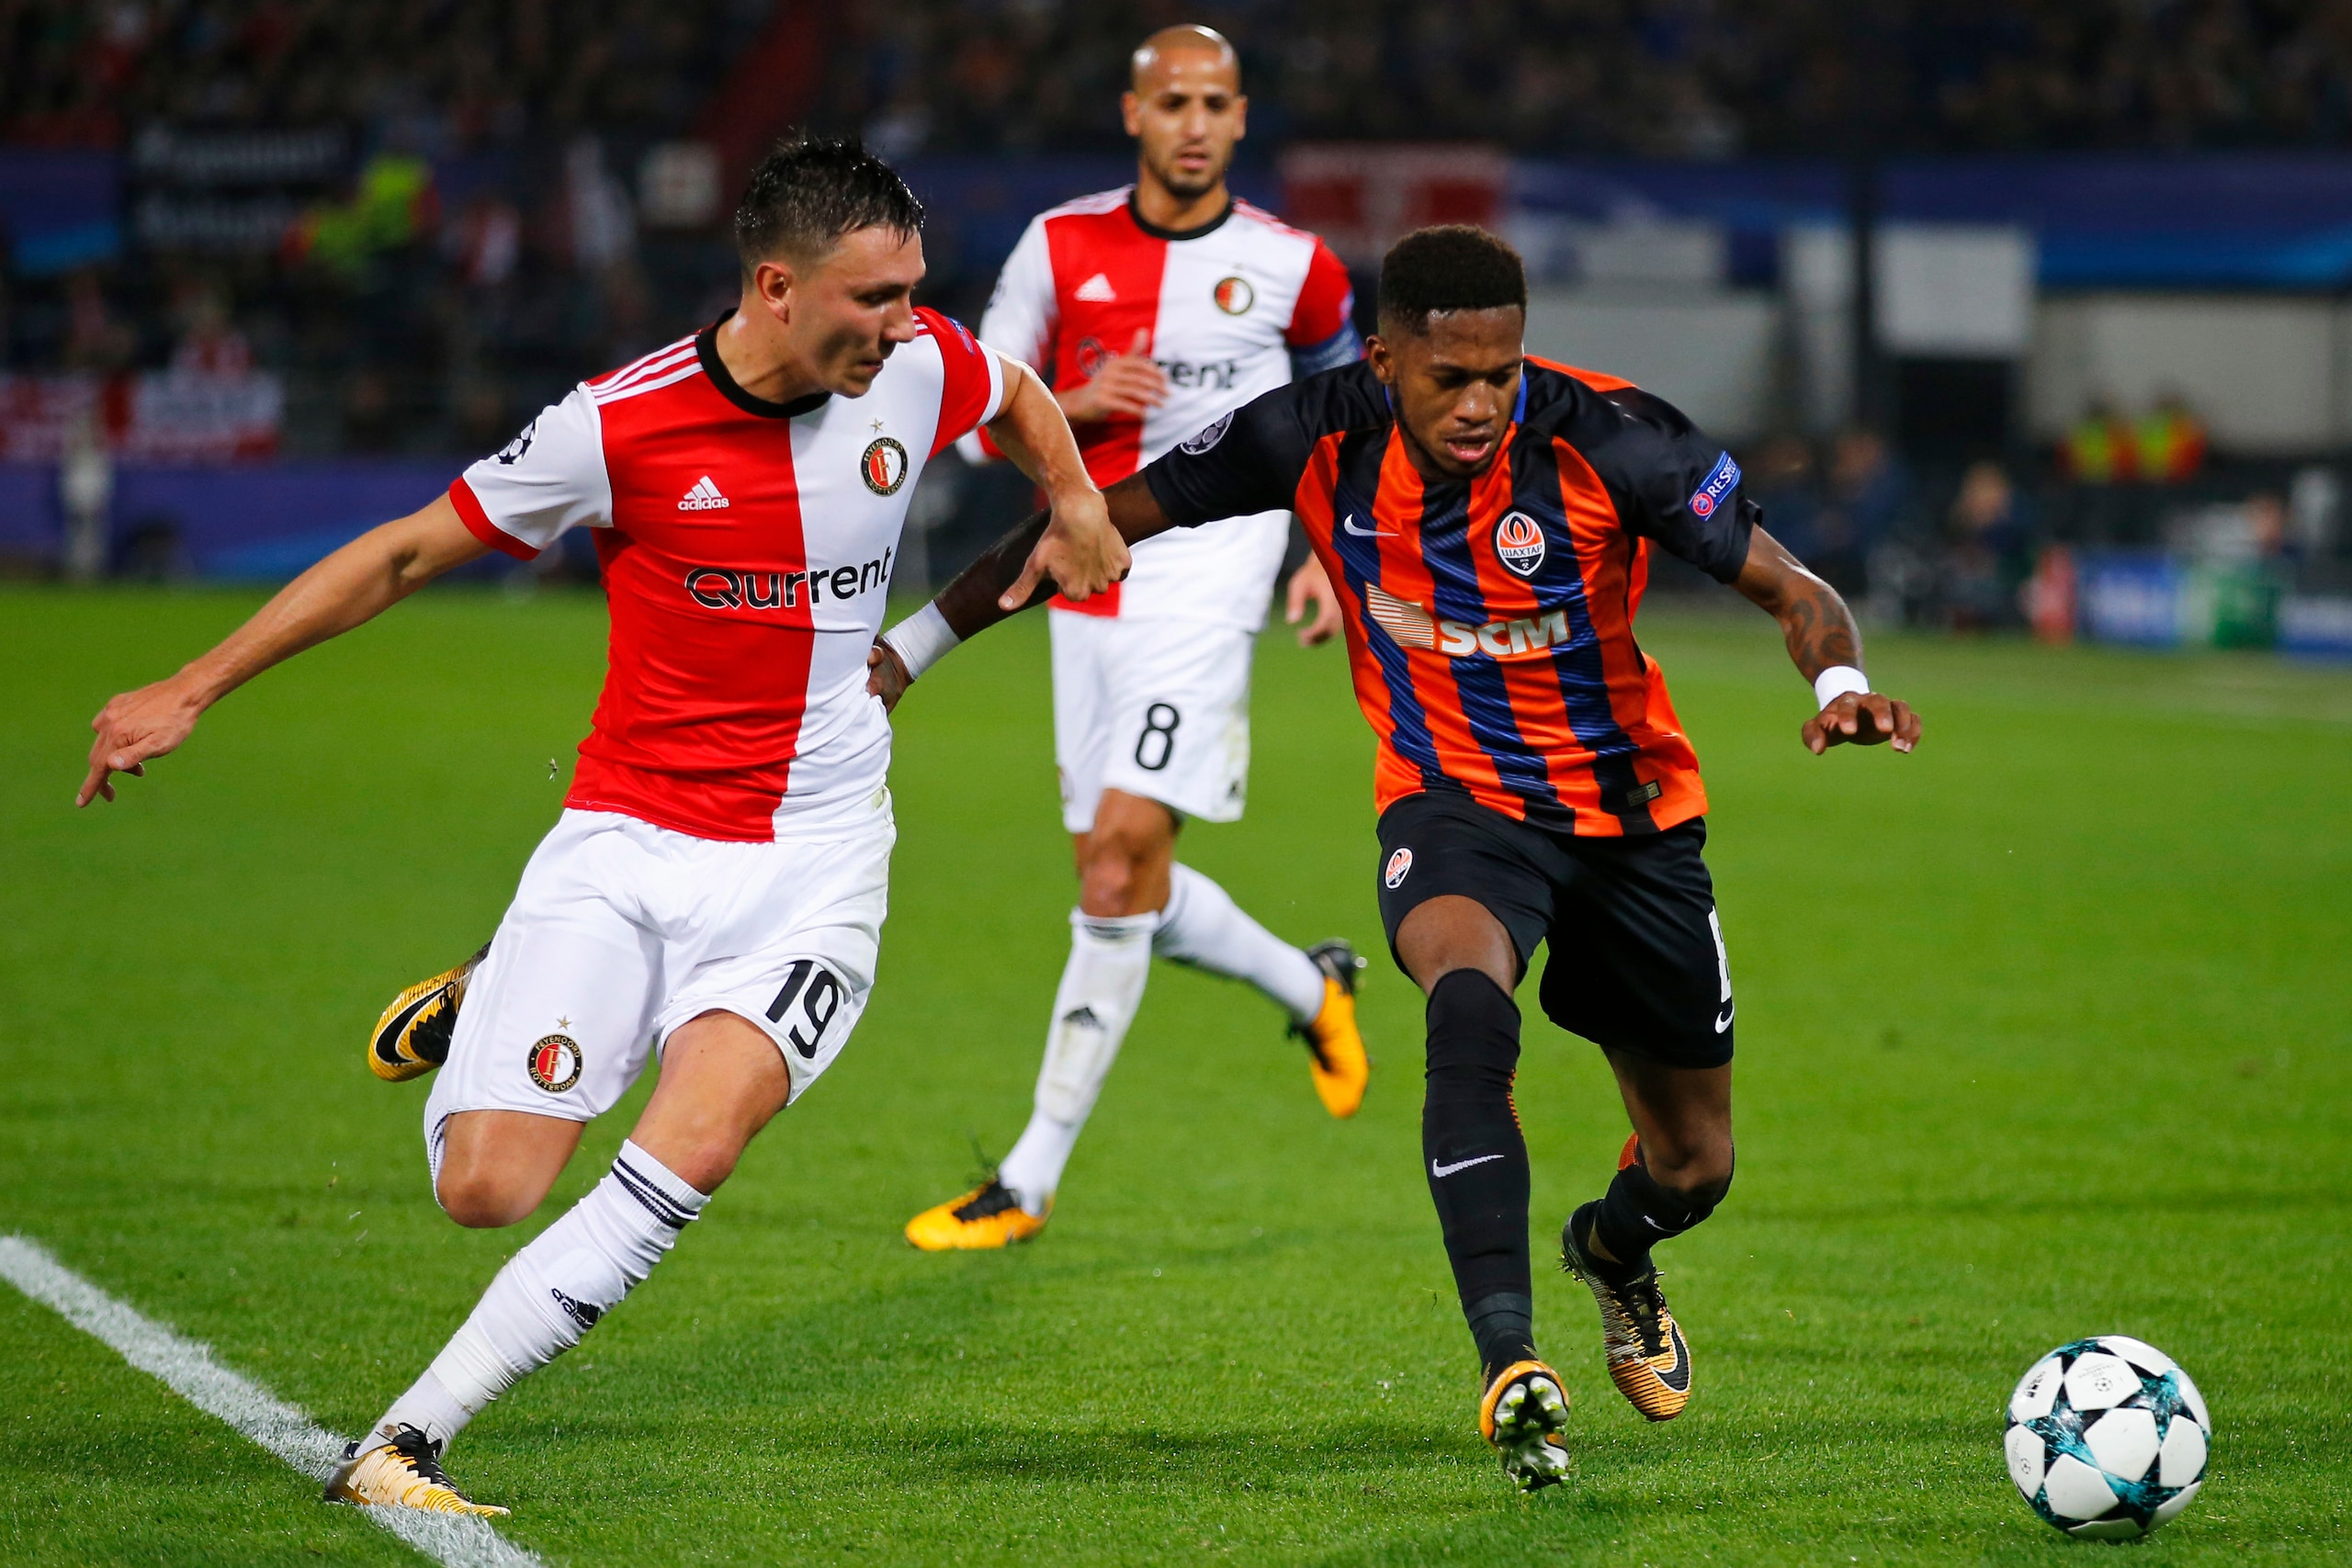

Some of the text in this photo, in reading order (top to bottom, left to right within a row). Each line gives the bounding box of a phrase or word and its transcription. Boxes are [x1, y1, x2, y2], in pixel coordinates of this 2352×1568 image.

[677, 496, 730, 511] adidas
[1501, 544, 1543, 557] ШАХТАР
[684, 546, 892, 610] Qurrent
[1440, 610, 1569, 656] SCM
[1135, 703, 1181, 771] 8
[764, 958, 840, 1060] 19
[536, 1035, 581, 1058] FEYENOORD
[529, 1066, 577, 1091] ROTTERDAM
